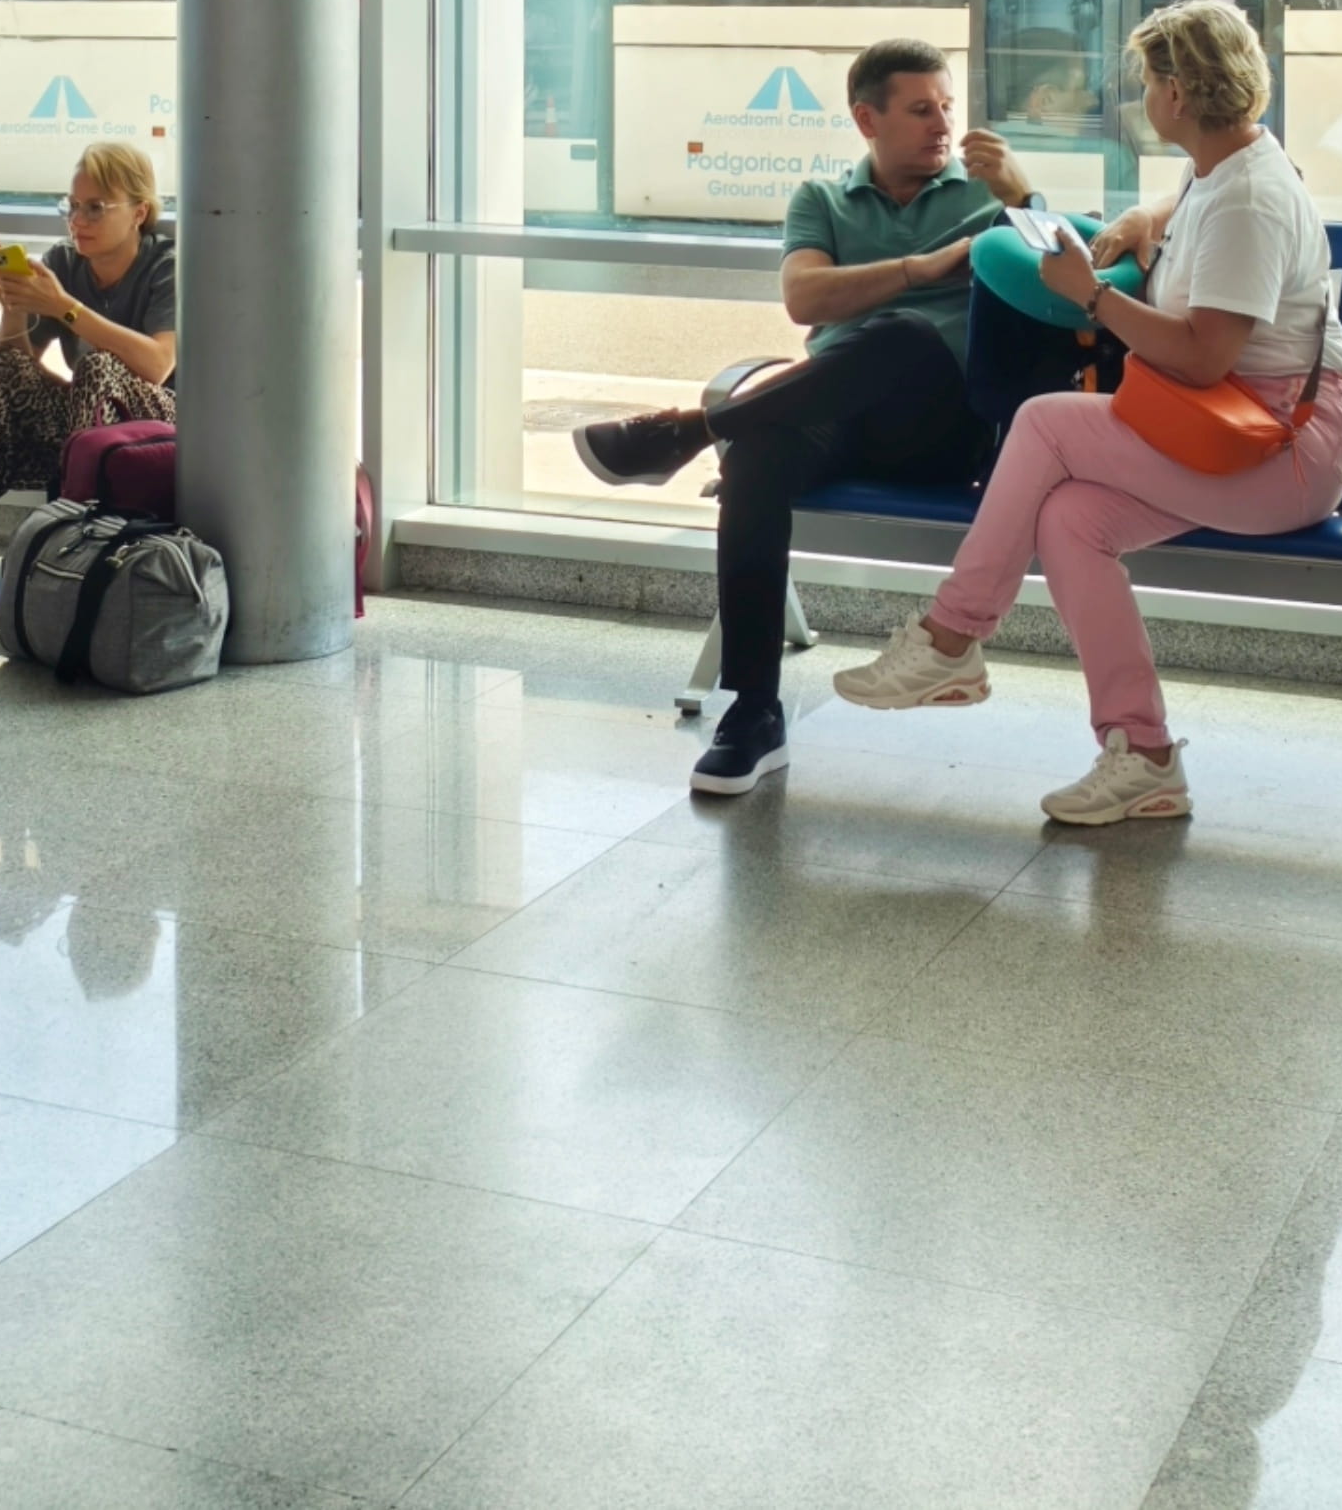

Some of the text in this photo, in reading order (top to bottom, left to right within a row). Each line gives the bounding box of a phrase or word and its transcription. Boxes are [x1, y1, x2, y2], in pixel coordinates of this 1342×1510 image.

[65, 121, 98, 135] Crne
[102, 121, 137, 136] Gore
[704, 111, 854, 129] Aerodromi Crne Go
[686, 151, 854, 176] Podgorica Airp
[707, 180, 776, 198] Ground
